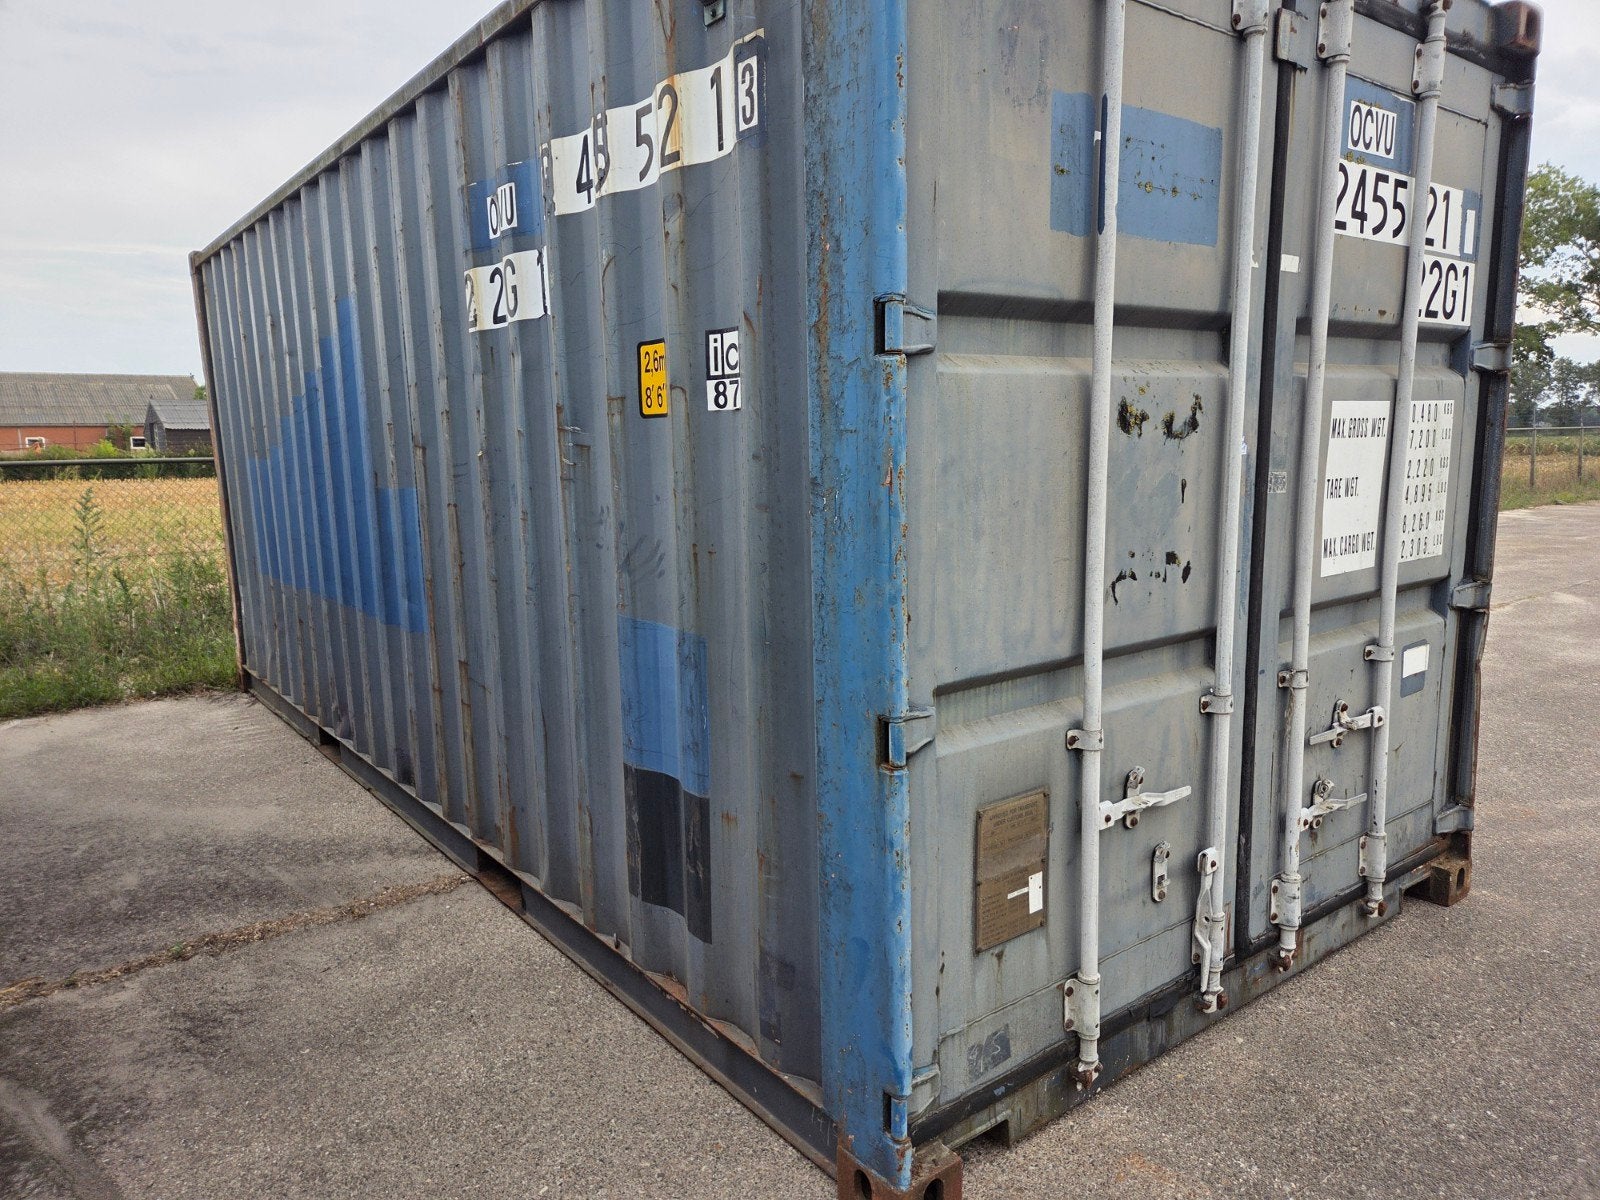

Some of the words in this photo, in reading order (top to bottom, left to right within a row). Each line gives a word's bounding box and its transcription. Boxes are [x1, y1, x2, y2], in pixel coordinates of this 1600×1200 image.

[741, 62, 755, 126] 3
[1350, 105, 1395, 156] OCVU
[1418, 259, 1470, 322] 2G1
[713, 380, 739, 409] 87
[1331, 417, 1346, 439] MAX.
[1348, 417, 1369, 439] GROSS
[1371, 417, 1386, 438] WGT.
[1326, 478, 1342, 499] TARE
[1345, 477, 1359, 498] WGT.
[1323, 537, 1338, 559] MAX.
[1339, 533, 1359, 556] CARGO
[1361, 531, 1375, 552] WGT.
